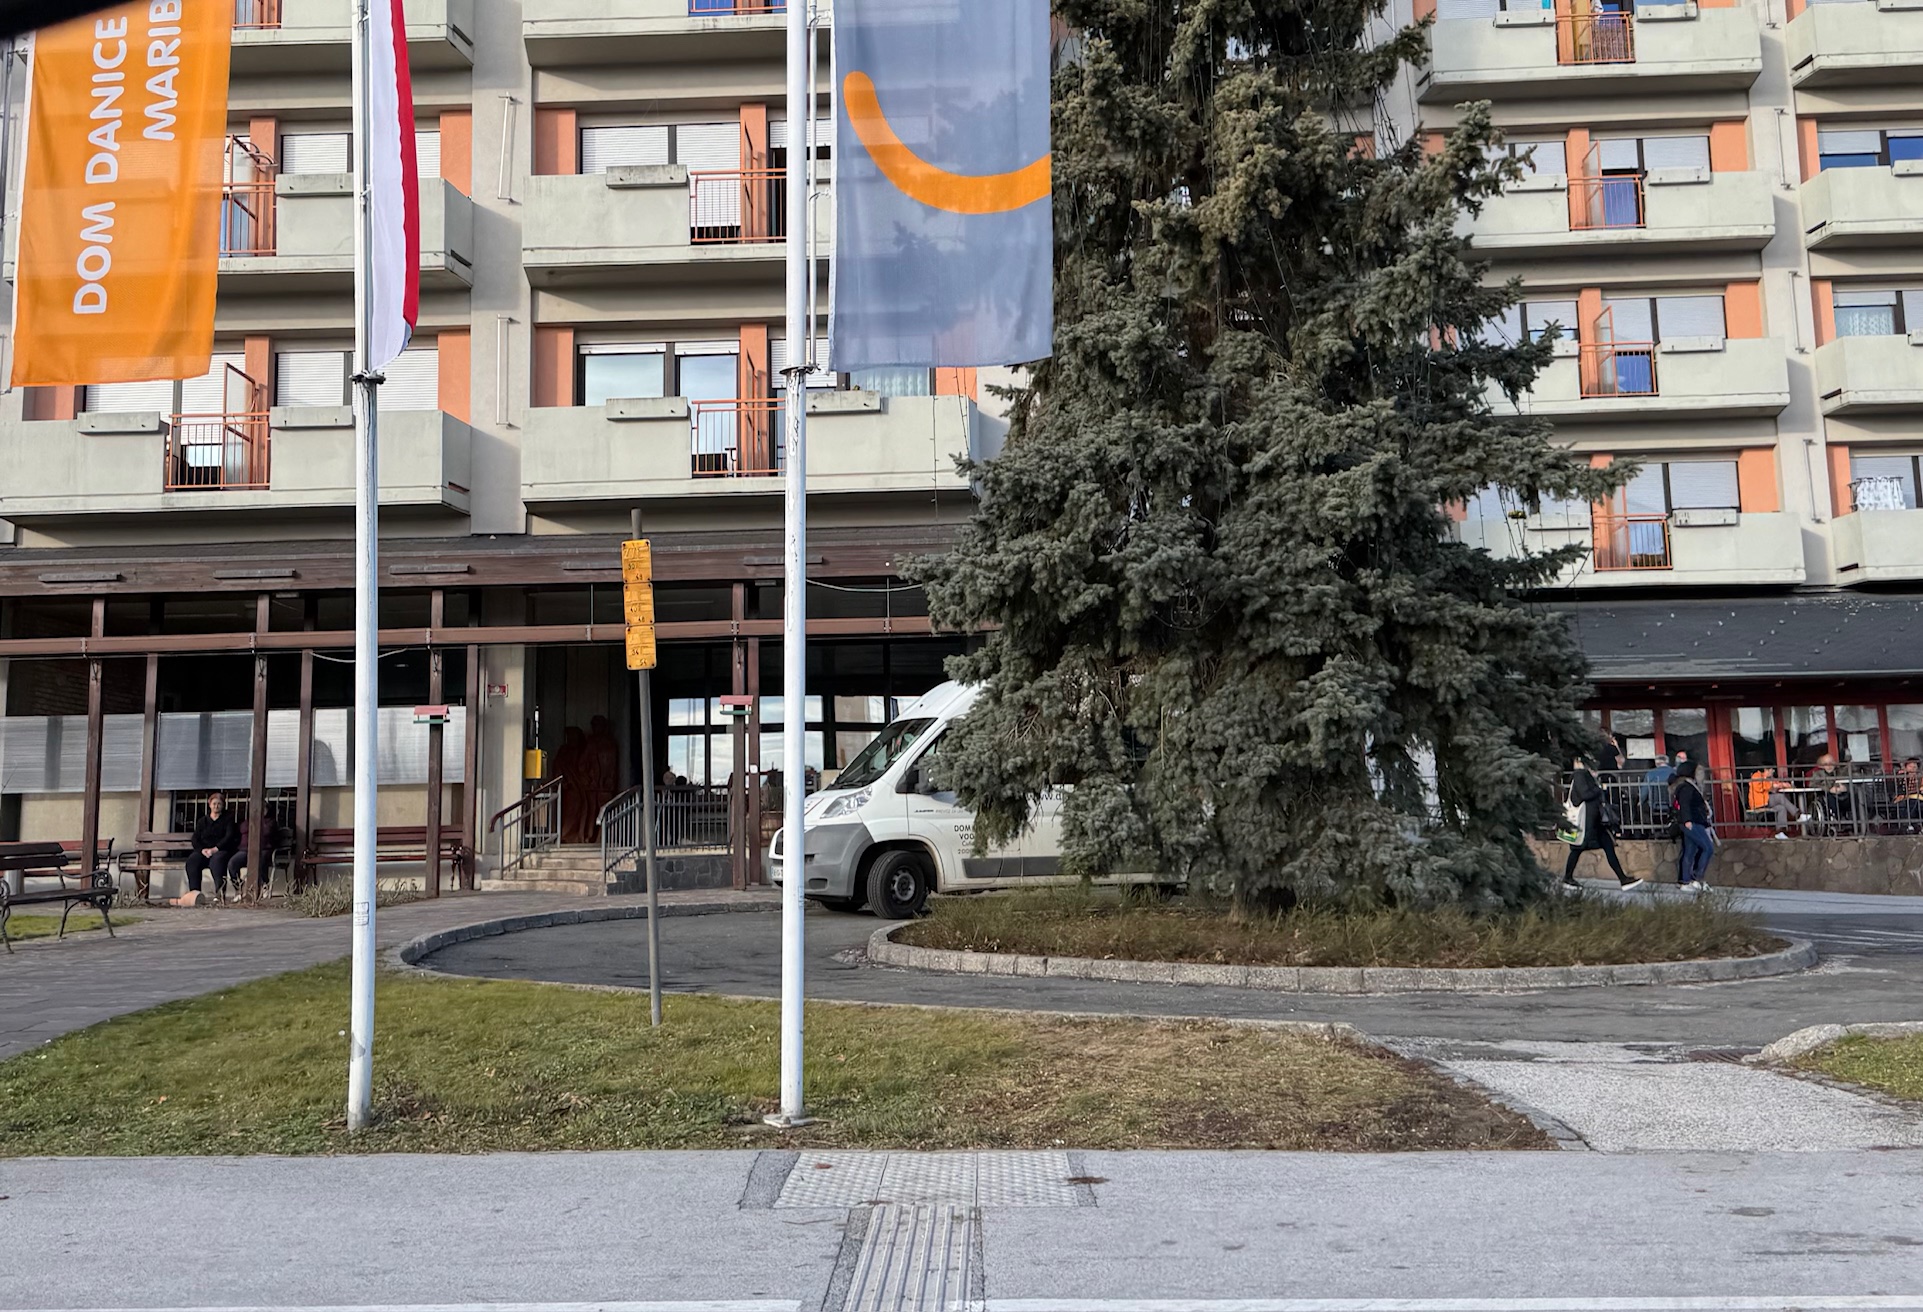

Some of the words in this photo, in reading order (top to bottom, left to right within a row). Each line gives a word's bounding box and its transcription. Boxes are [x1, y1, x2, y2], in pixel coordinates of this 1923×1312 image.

[85, 16, 128, 185] DANICE
[142, 0, 182, 141] MARIB
[73, 201, 116, 314] DOM
